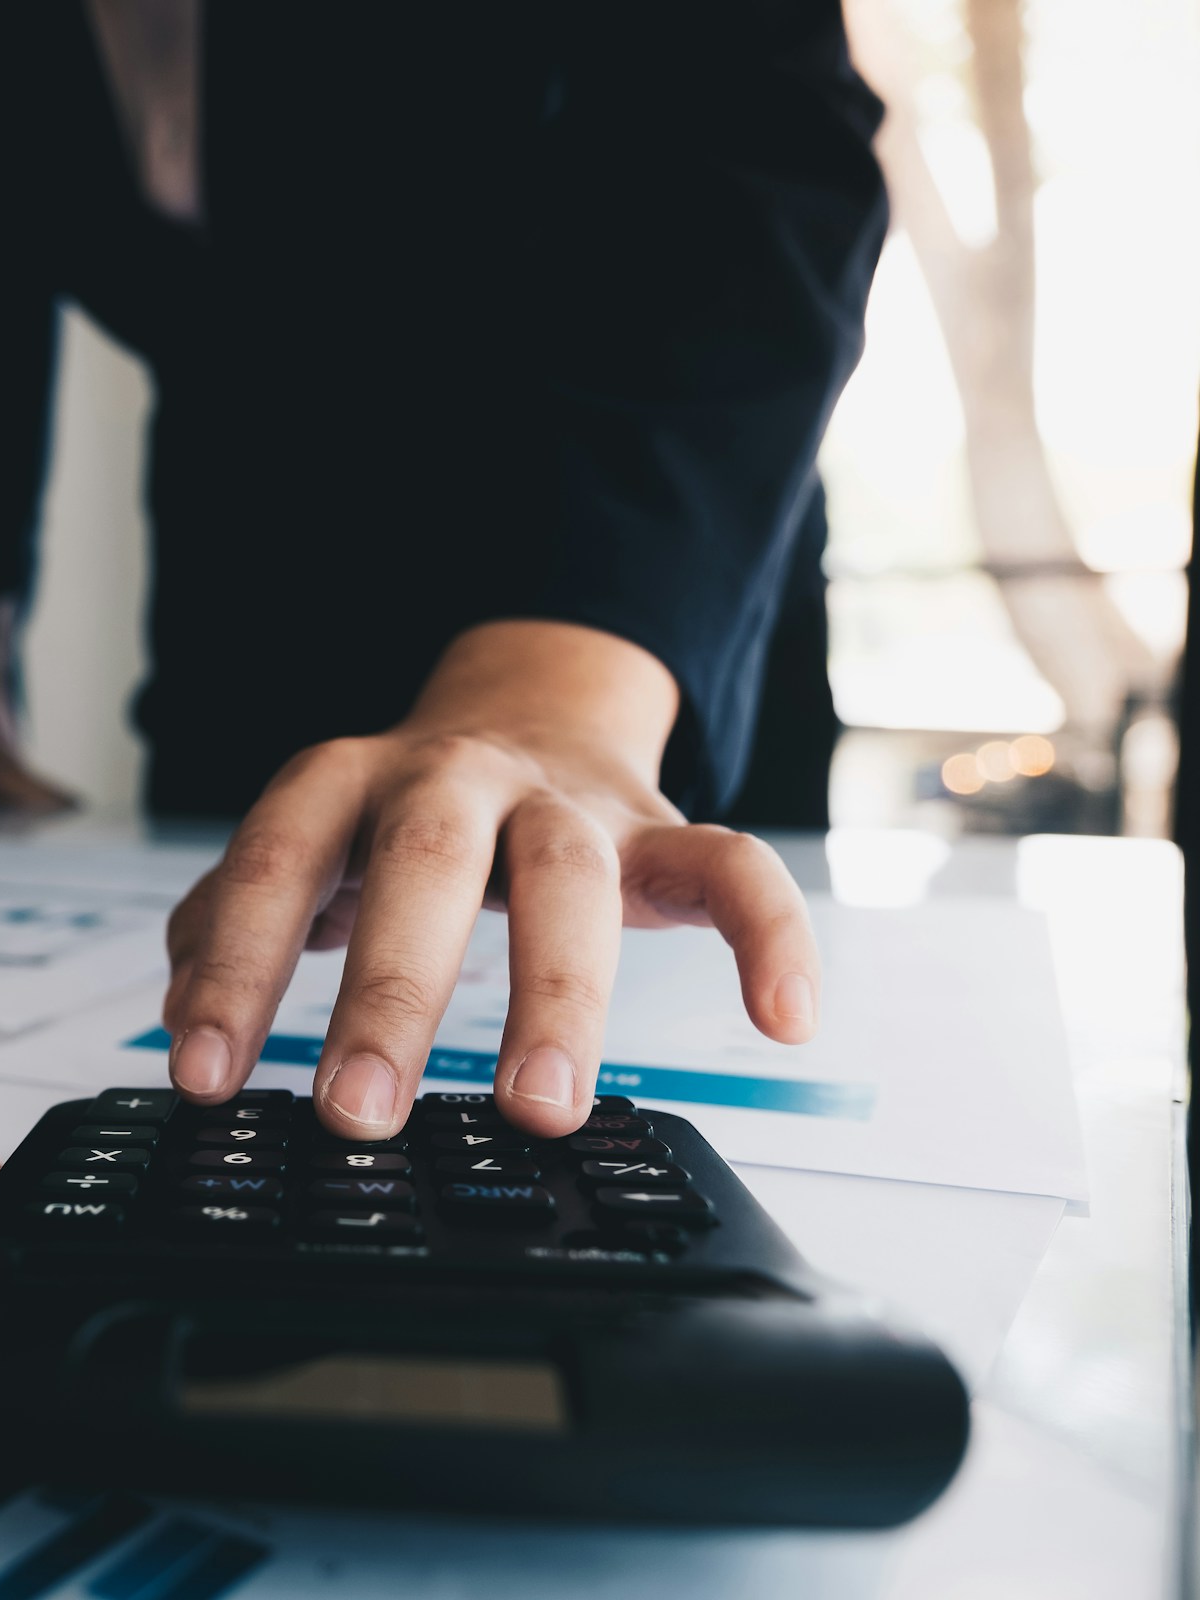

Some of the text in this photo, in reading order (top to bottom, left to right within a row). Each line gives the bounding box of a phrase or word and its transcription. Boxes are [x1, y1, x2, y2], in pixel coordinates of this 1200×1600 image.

[236, 1109, 263, 1120] 3
[460, 1112, 477, 1123] 1
[229, 1129, 257, 1142] 6
[462, 1133, 493, 1146] 4
[588, 1137, 642, 1151] AC
[223, 1152, 254, 1165] 9
[345, 1153, 375, 1168] 8
[471, 1158, 502, 1171] 7
[452, 1183, 534, 1200] MRC
[43, 1203, 106, 1217] MU
